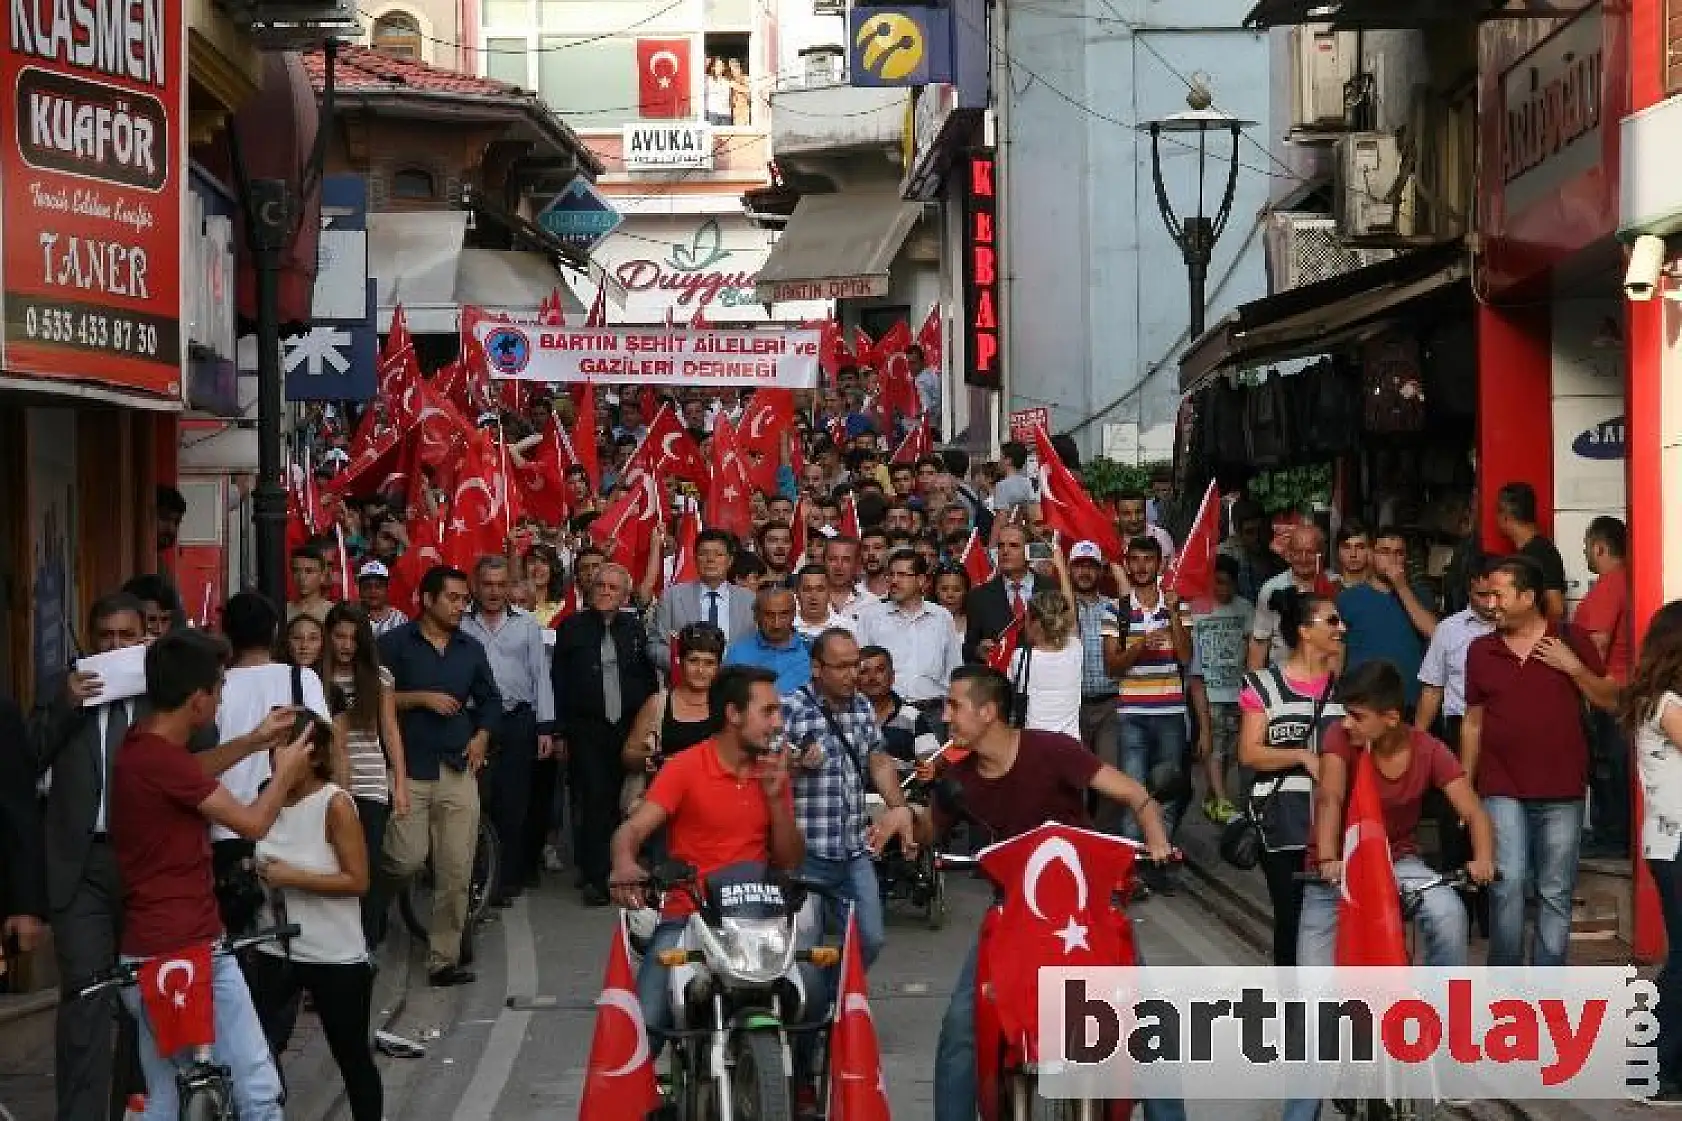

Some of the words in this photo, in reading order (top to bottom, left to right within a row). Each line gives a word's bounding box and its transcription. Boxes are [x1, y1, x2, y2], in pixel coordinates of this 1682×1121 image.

[31, 93, 156, 176] KUAFÖR
[39, 232, 149, 299] TANER
[971, 159, 997, 372] KEBAP
[26, 306, 37, 337] 0
[540, 333, 617, 351] BARTIN
[625, 333, 687, 355] ŞEHİT
[695, 333, 787, 355] AİLELERİ
[791, 341, 817, 355] ve
[579, 357, 674, 376] GAZİLERİ
[682, 359, 777, 378] DERNEĞİ
